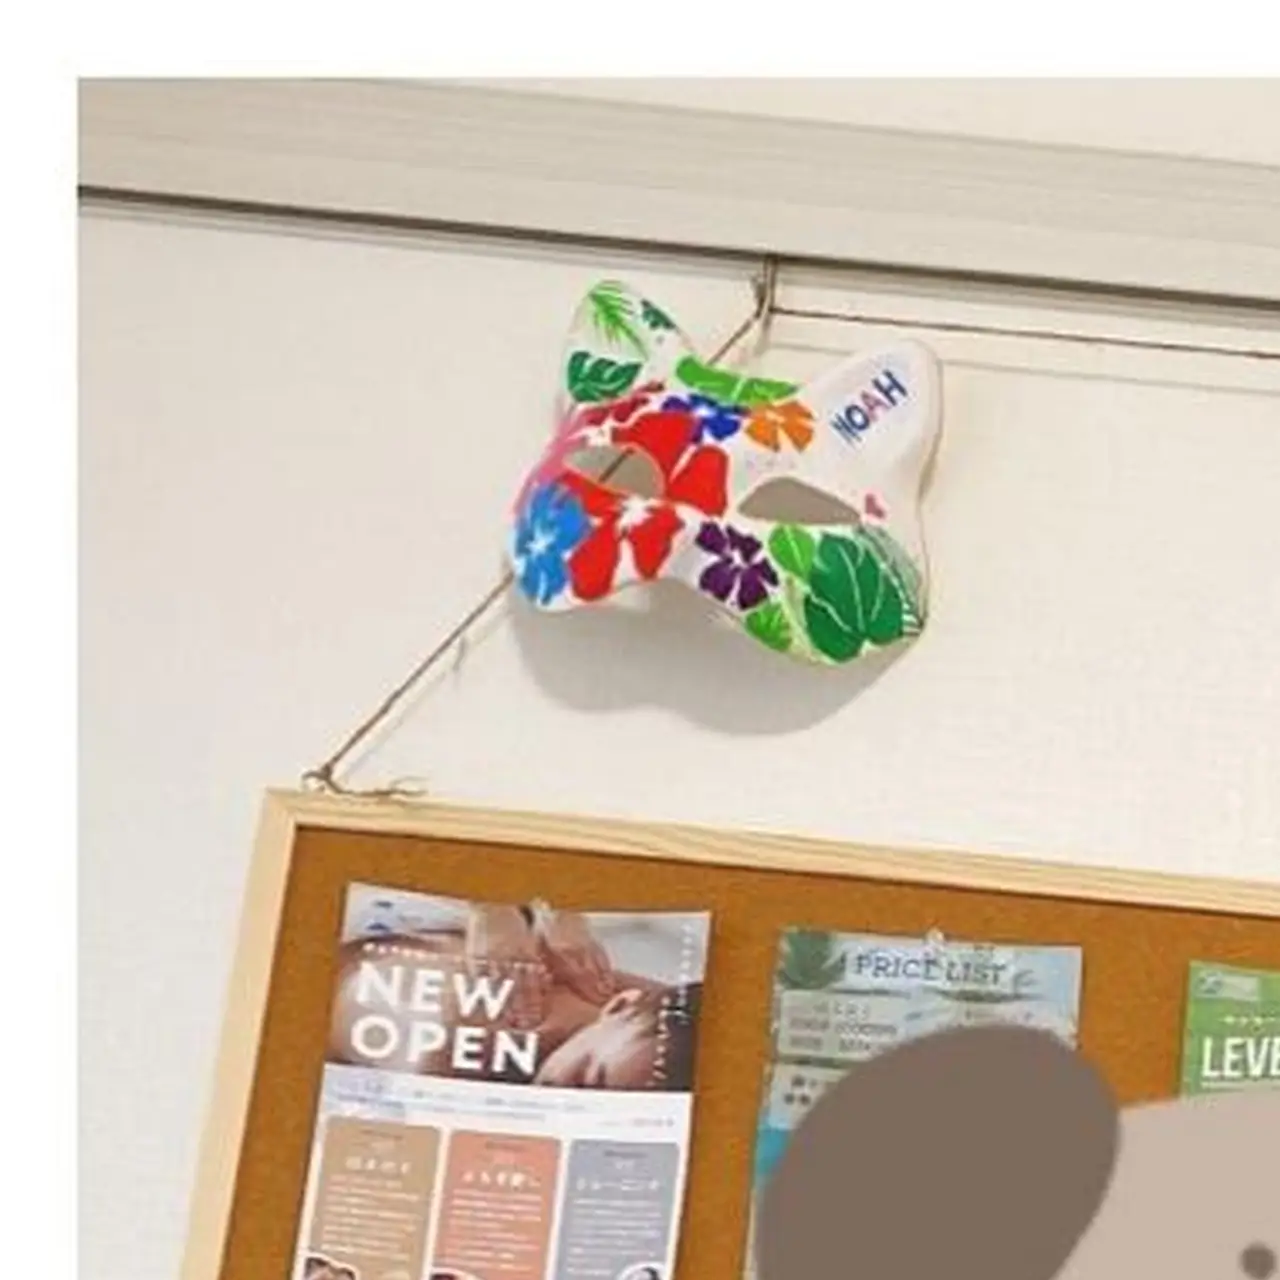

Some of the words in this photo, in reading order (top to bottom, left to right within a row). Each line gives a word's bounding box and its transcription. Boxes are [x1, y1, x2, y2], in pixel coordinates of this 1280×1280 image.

[828, 368, 908, 445] NOAH
[355, 960, 516, 1021] NEW
[855, 954, 938, 982] PRICE
[946, 961, 1007, 986] LIST
[350, 1015, 539, 1075] OPEN
